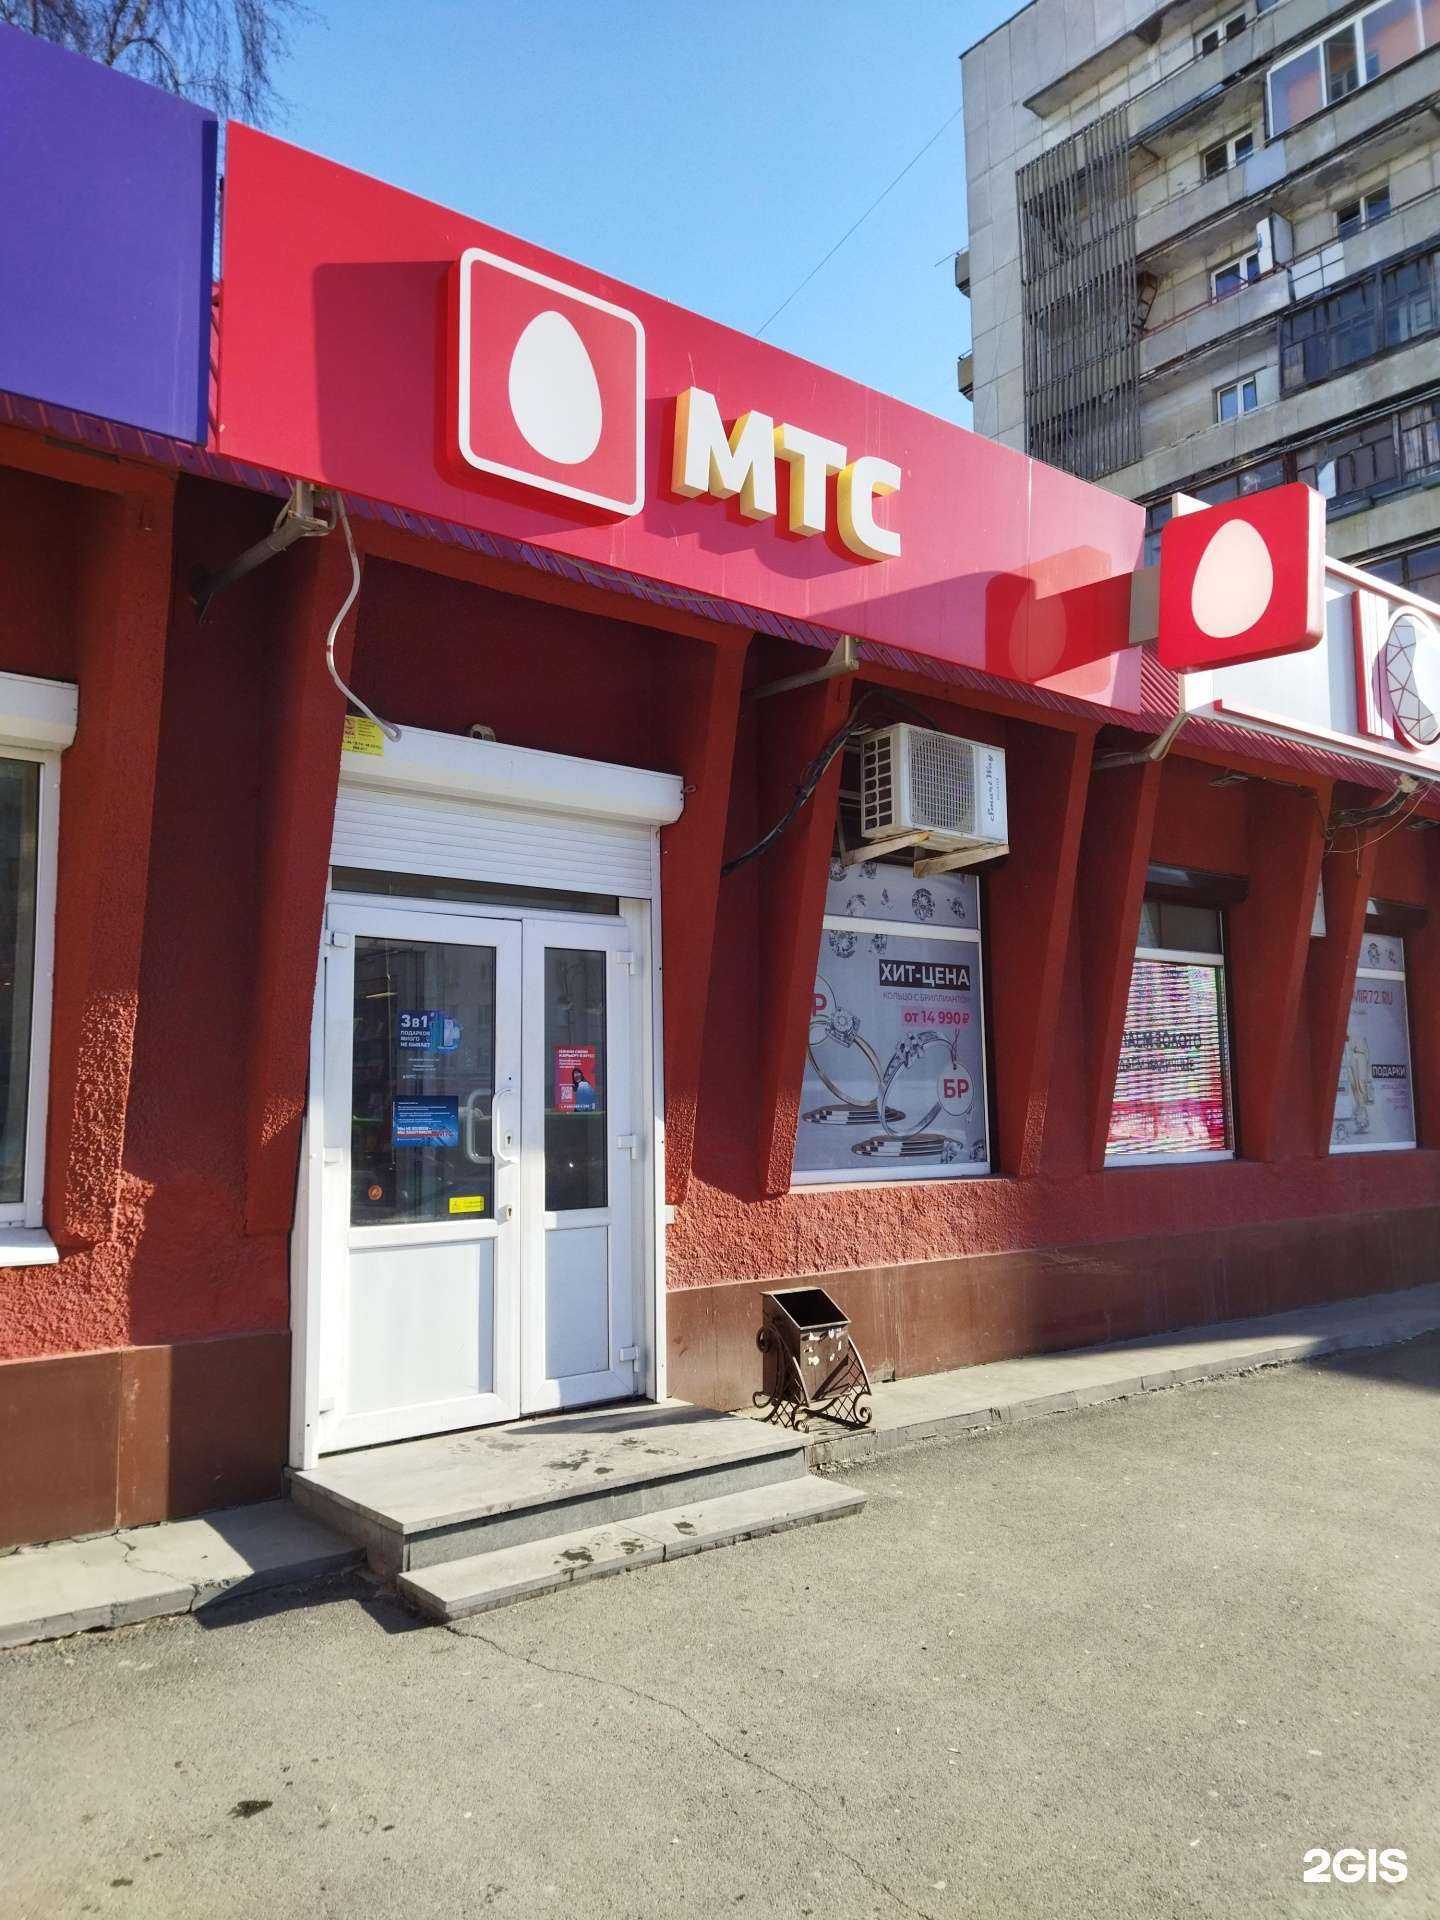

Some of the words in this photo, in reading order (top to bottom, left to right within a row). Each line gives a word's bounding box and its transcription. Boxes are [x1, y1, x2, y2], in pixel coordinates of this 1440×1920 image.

[672, 386, 902, 561] МТС
[881, 963, 970, 987] ХИТ-ЦЕНА
[921, 1011, 935, 1024] 14
[1372, 1065, 1406, 1078] ПОДАРКИ
[943, 1078, 970, 1099] БР
